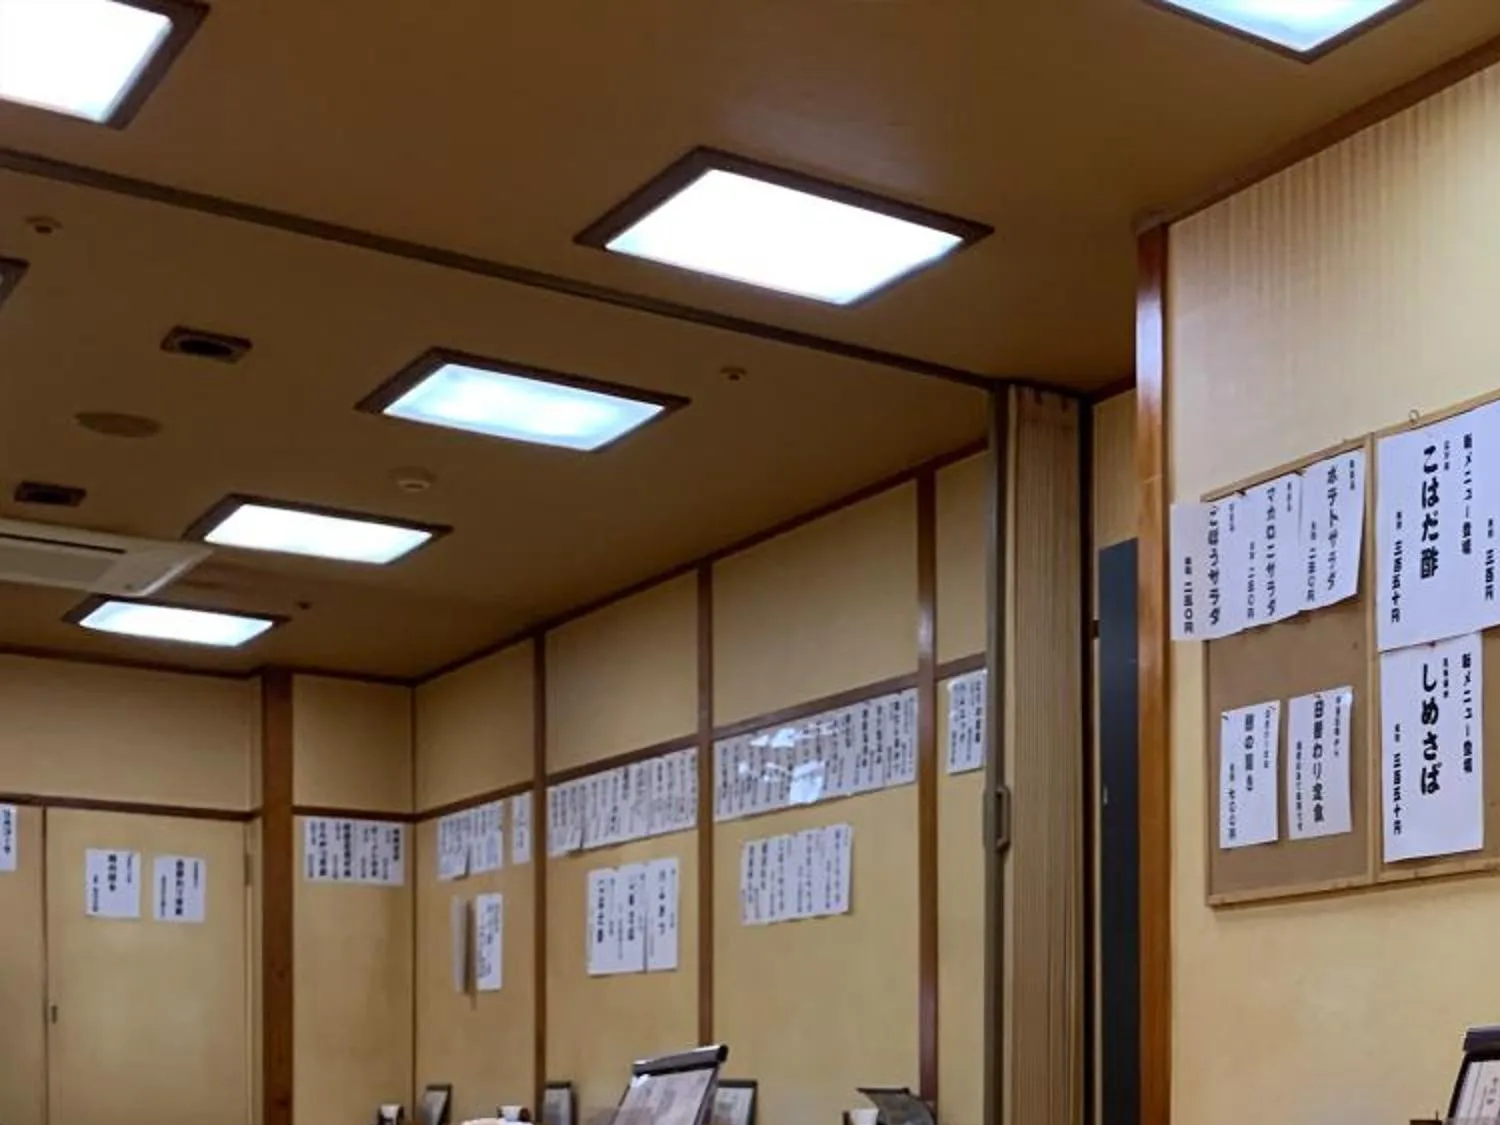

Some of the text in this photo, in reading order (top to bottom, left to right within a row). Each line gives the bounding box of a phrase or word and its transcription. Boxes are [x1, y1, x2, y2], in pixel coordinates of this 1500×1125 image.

[1266, 487, 1276, 616] マカロニサラダ
[1421, 664, 1441, 794] しめさば
